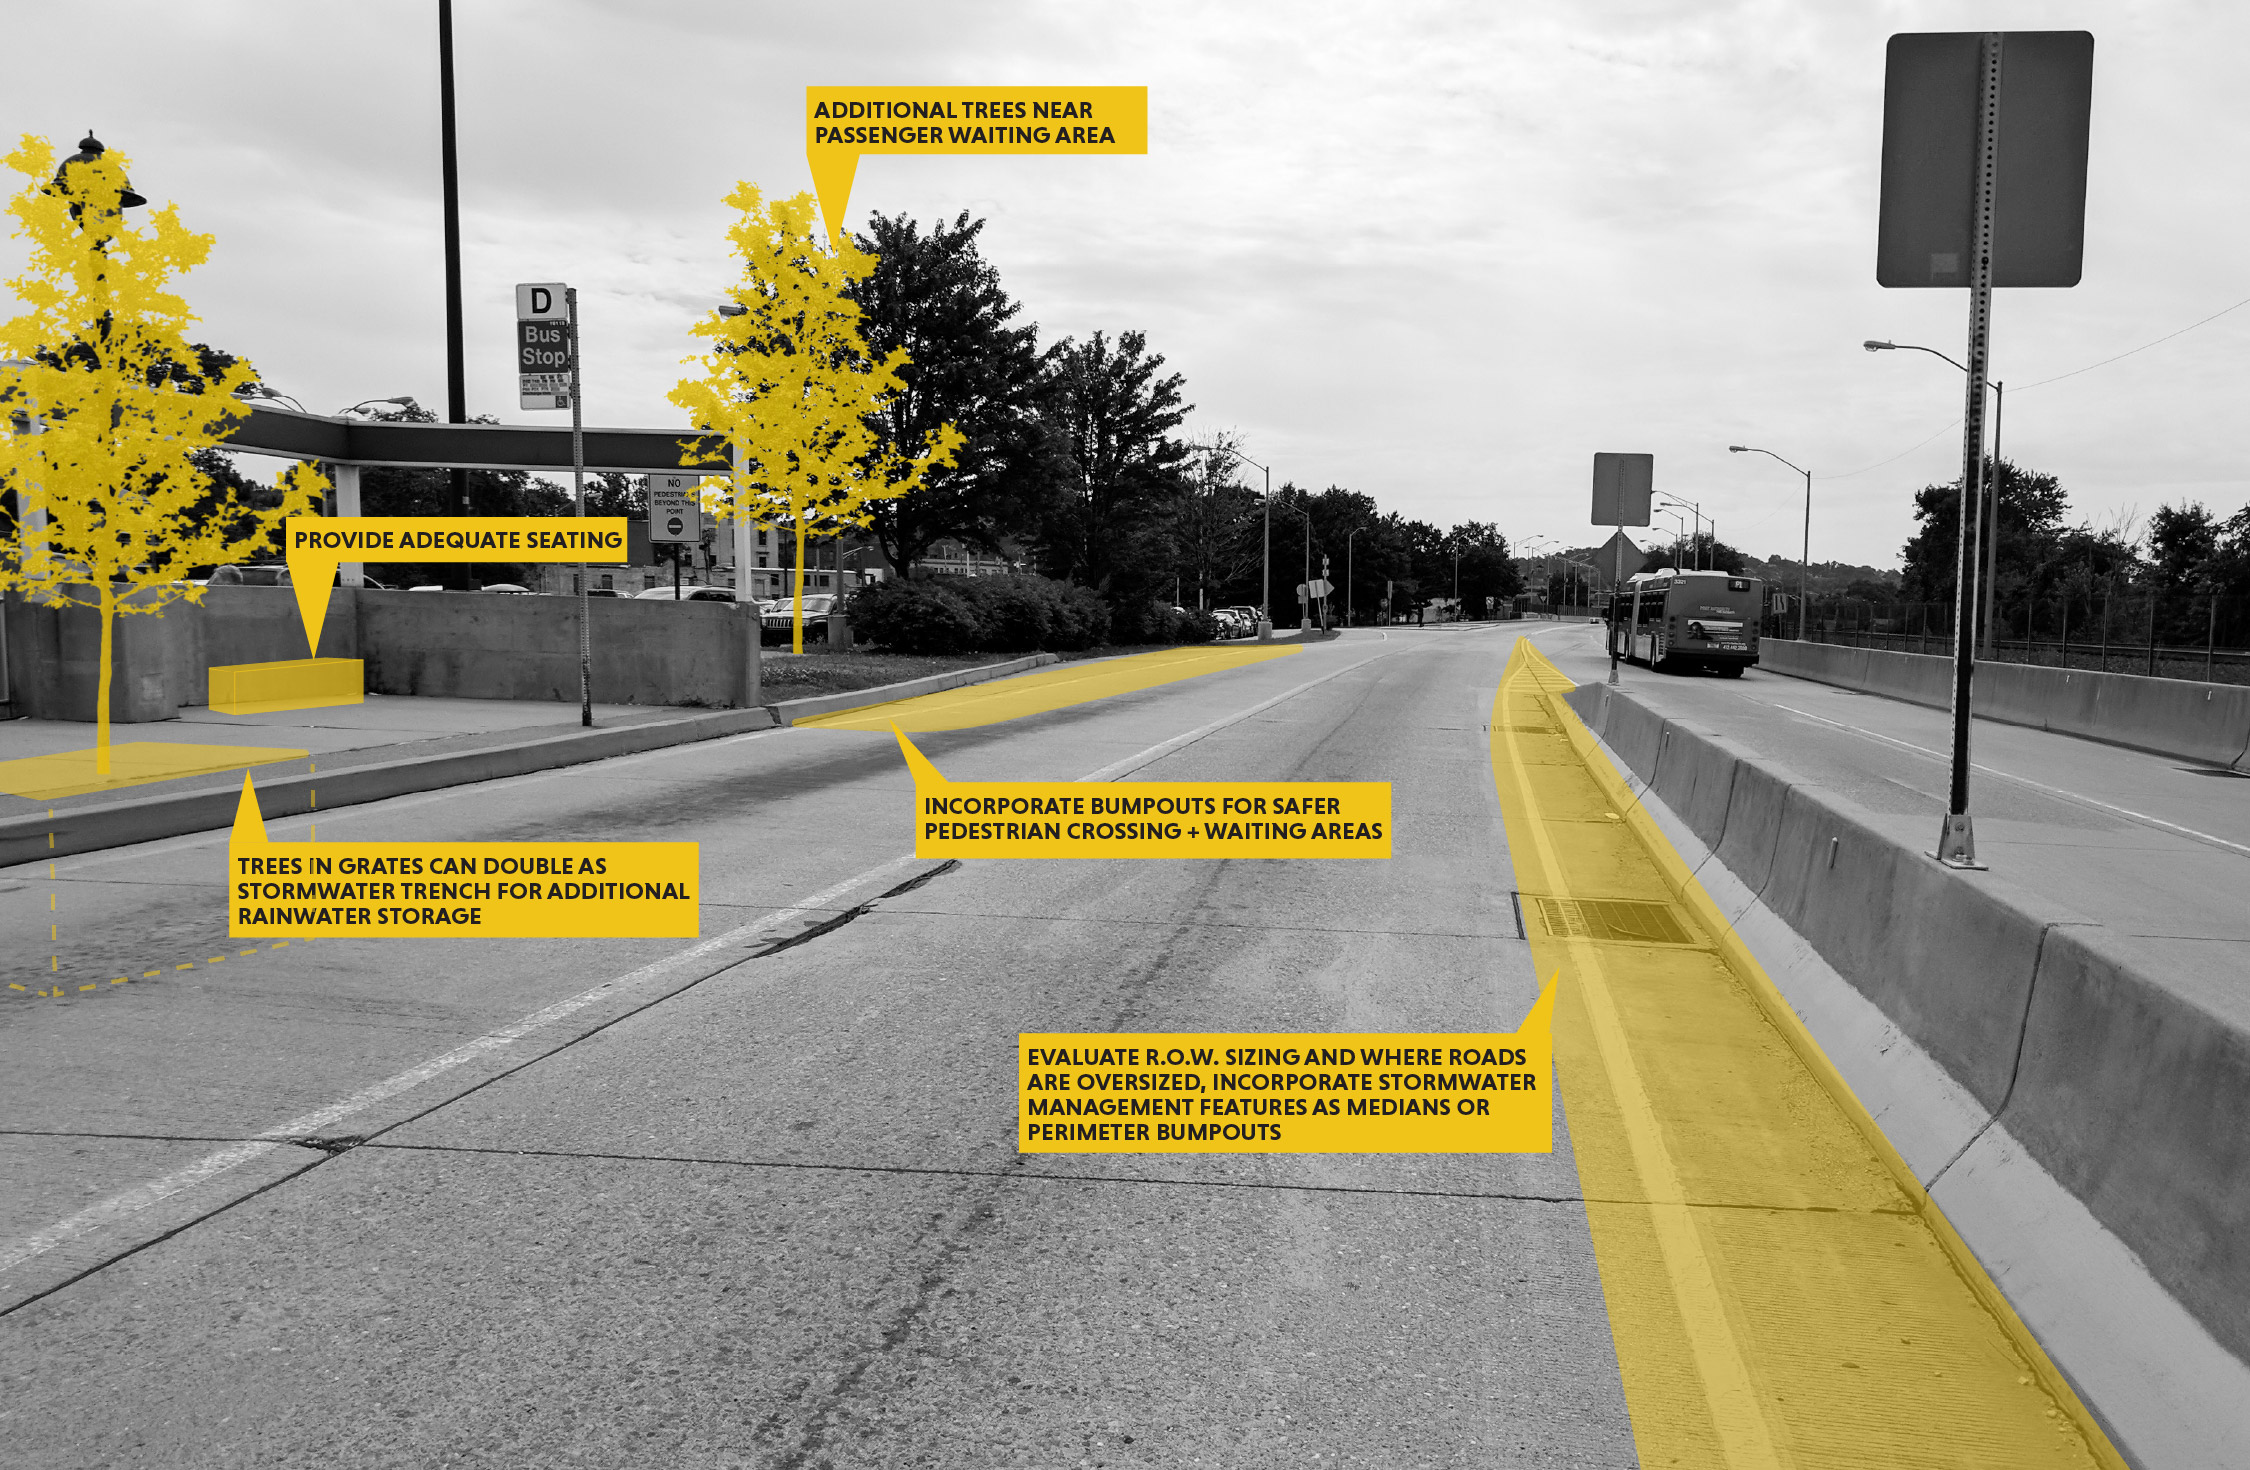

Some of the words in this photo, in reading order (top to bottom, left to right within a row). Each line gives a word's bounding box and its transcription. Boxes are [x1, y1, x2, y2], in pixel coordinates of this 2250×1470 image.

[531, 287, 552, 314] D
[525, 325, 561, 343] Bus
[522, 347, 566, 368] Stop
[667, 478, 681, 488] NO
